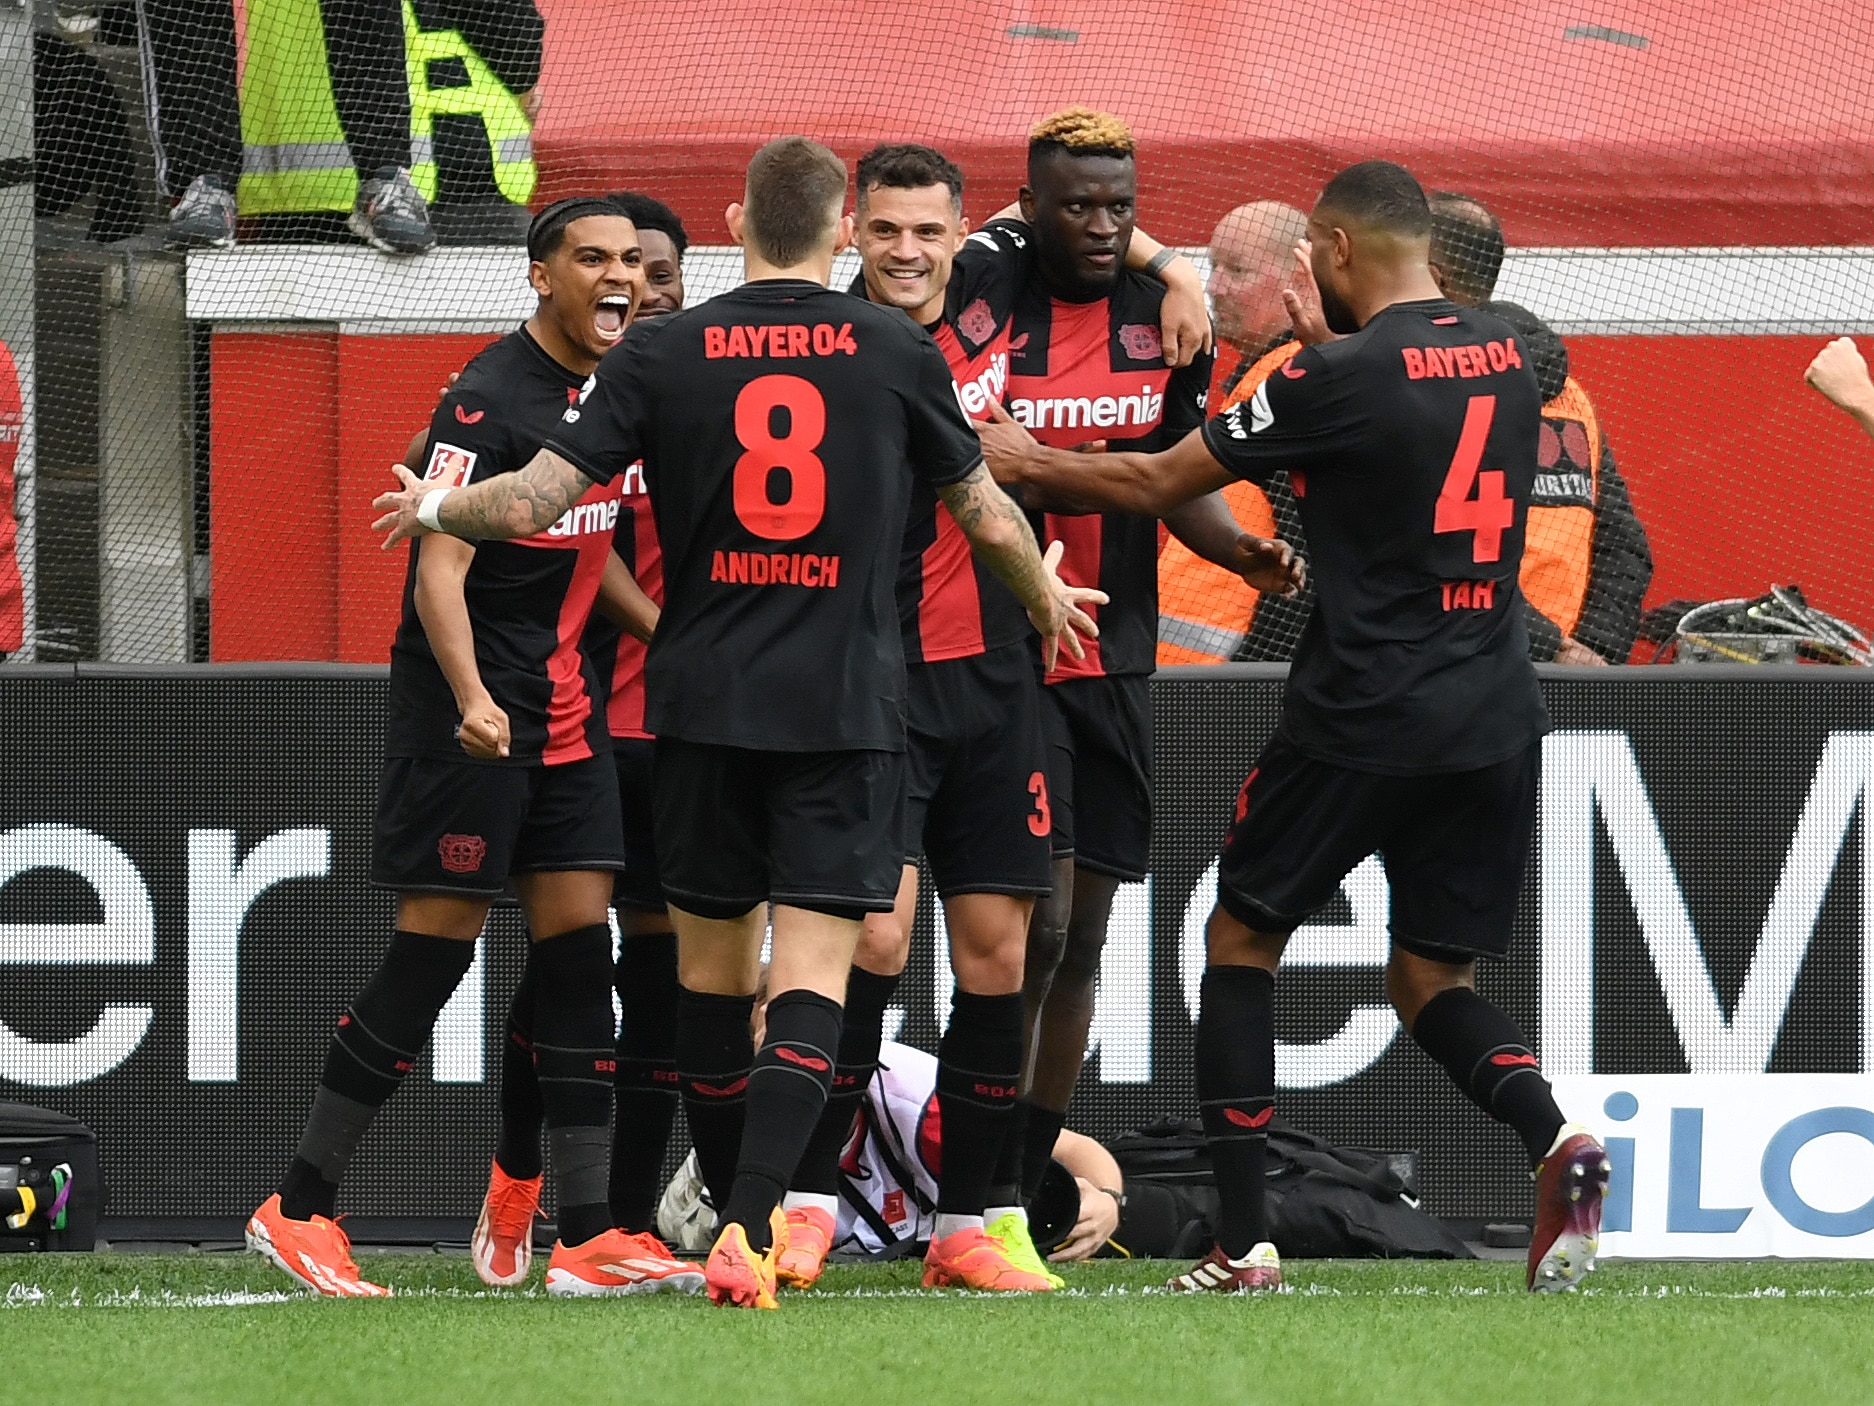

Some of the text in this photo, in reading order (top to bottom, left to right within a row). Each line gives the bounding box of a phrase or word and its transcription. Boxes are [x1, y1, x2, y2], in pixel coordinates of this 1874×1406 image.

[733, 374, 827, 541] 8
[1433, 394, 1514, 563] 4
[710, 550, 840, 588] ANDRICH
